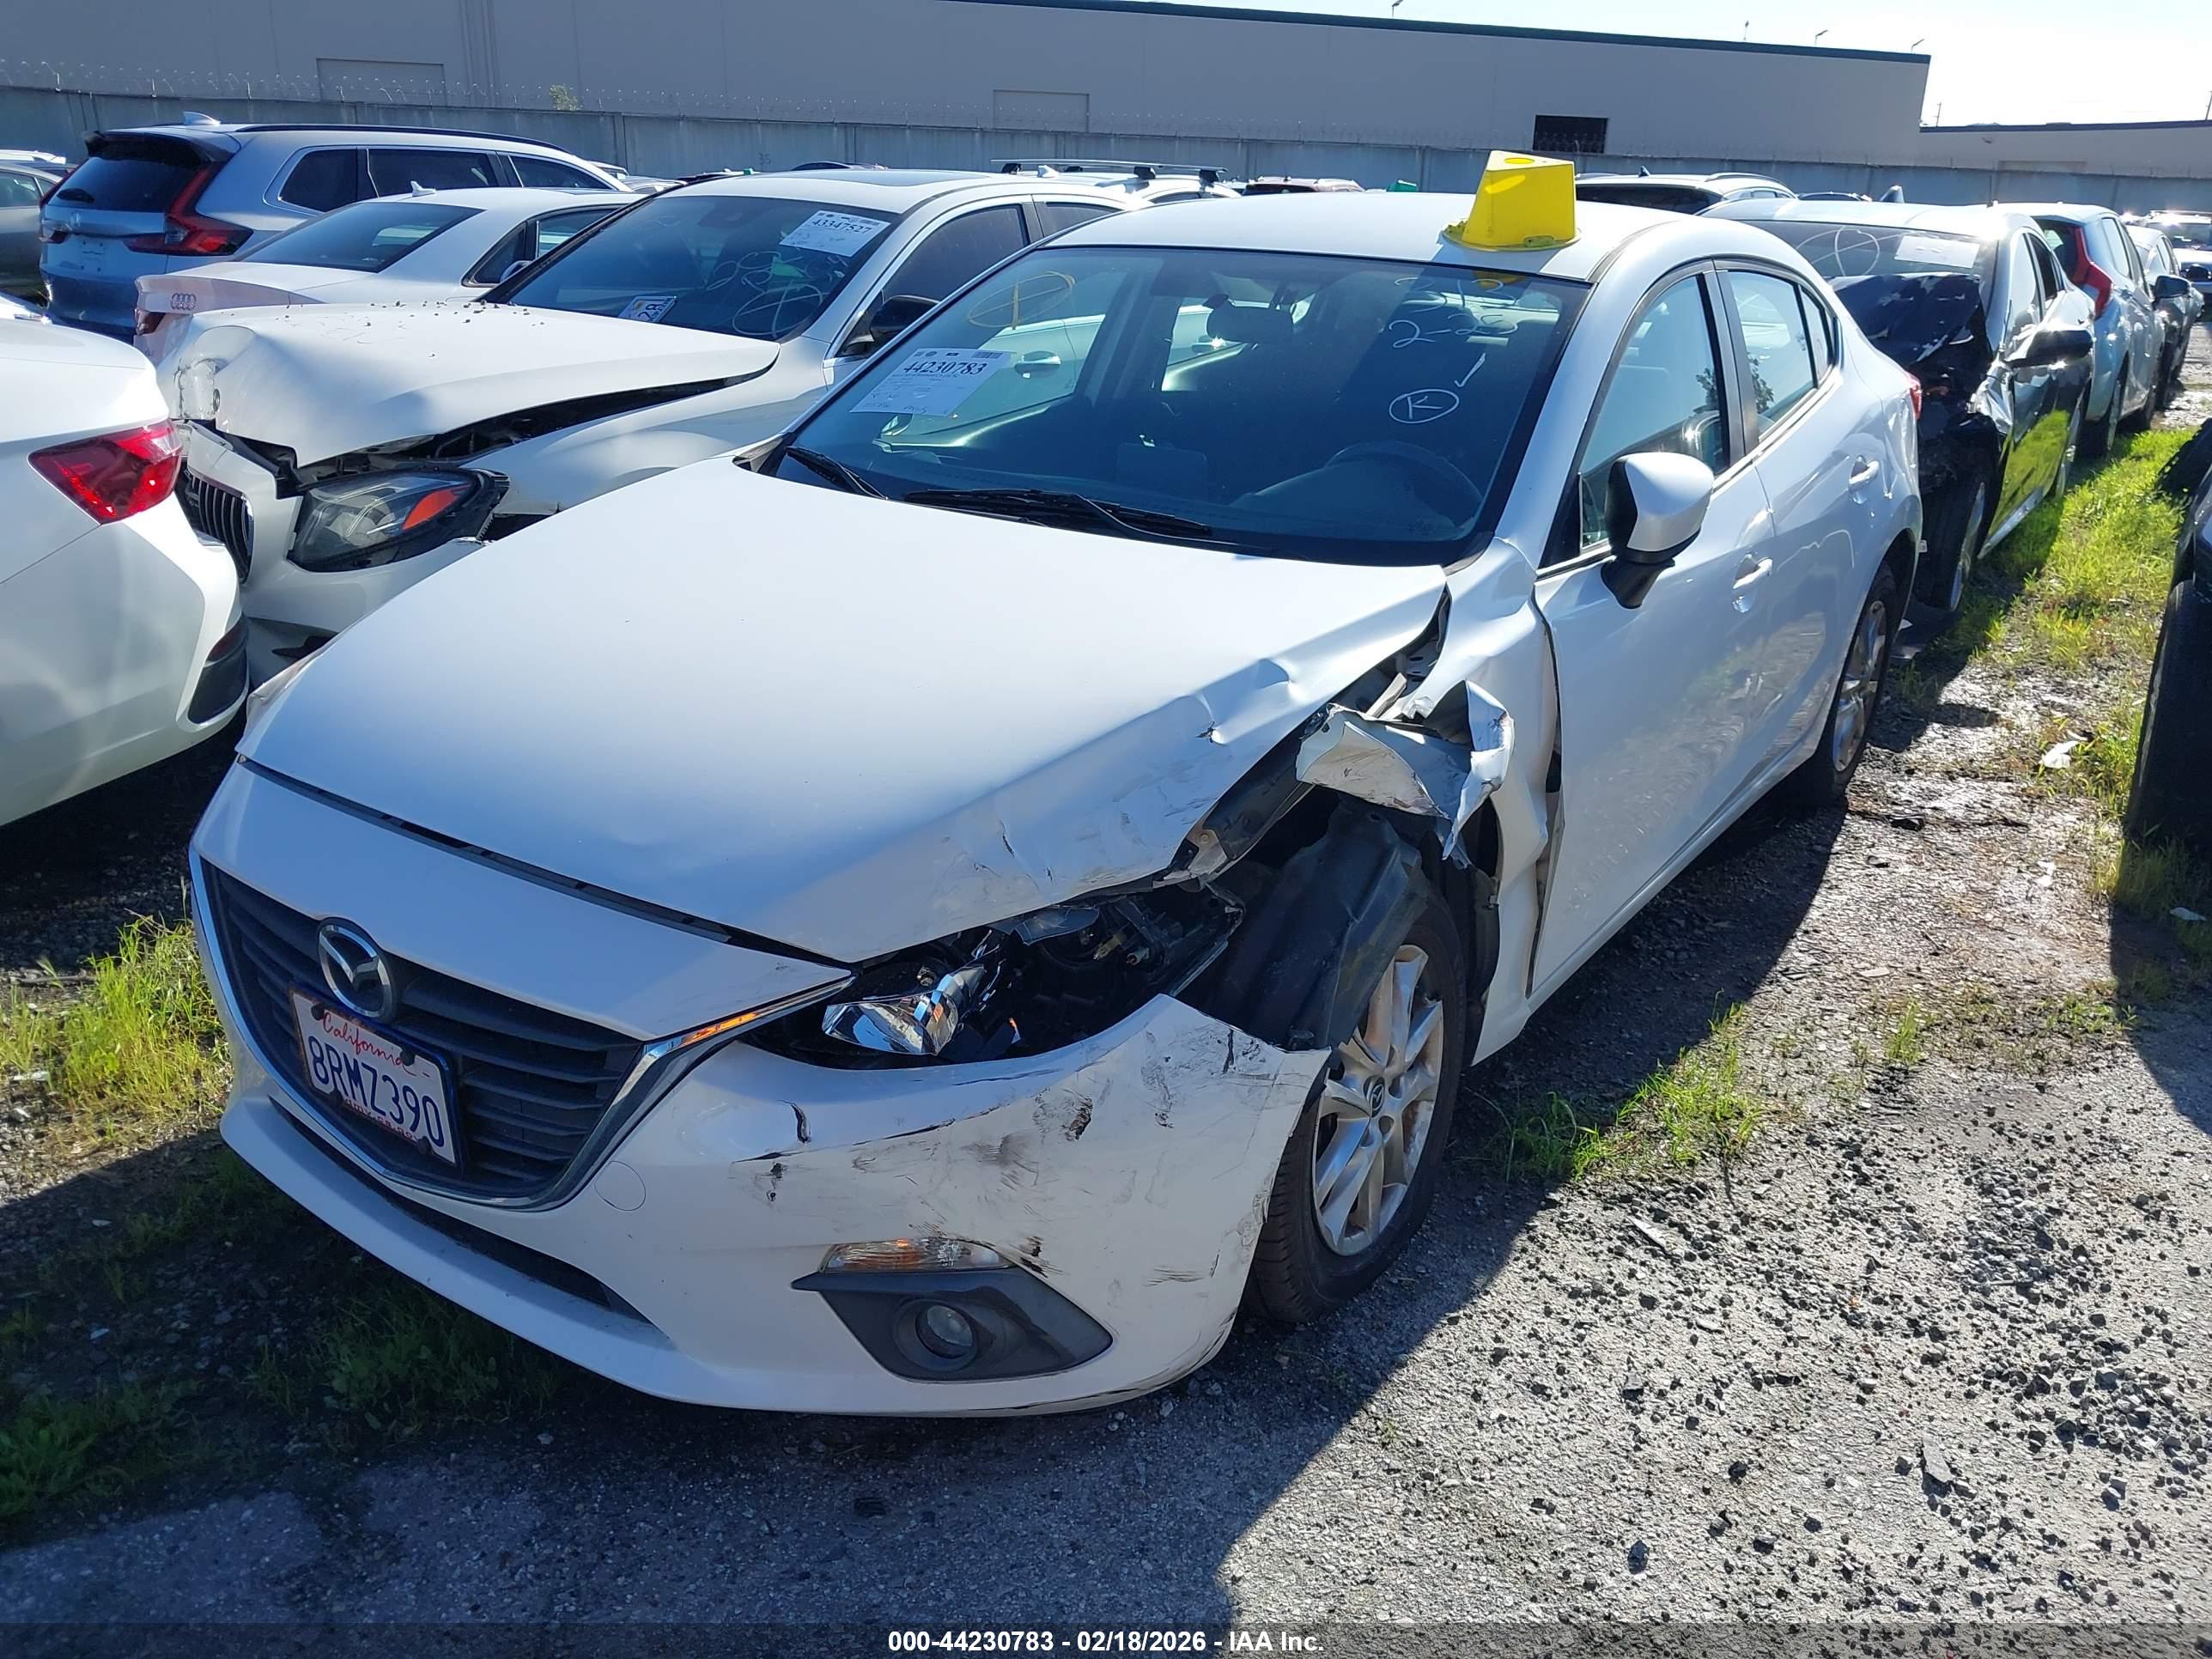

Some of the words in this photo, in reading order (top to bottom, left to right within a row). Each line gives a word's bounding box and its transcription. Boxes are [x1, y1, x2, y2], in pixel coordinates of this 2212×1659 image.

[810, 217, 872, 235] 43347527
[903, 361, 988, 375] 44230783
[320, 1012, 416, 1077] California
[307, 1036, 445, 1148] 8RMZ390
